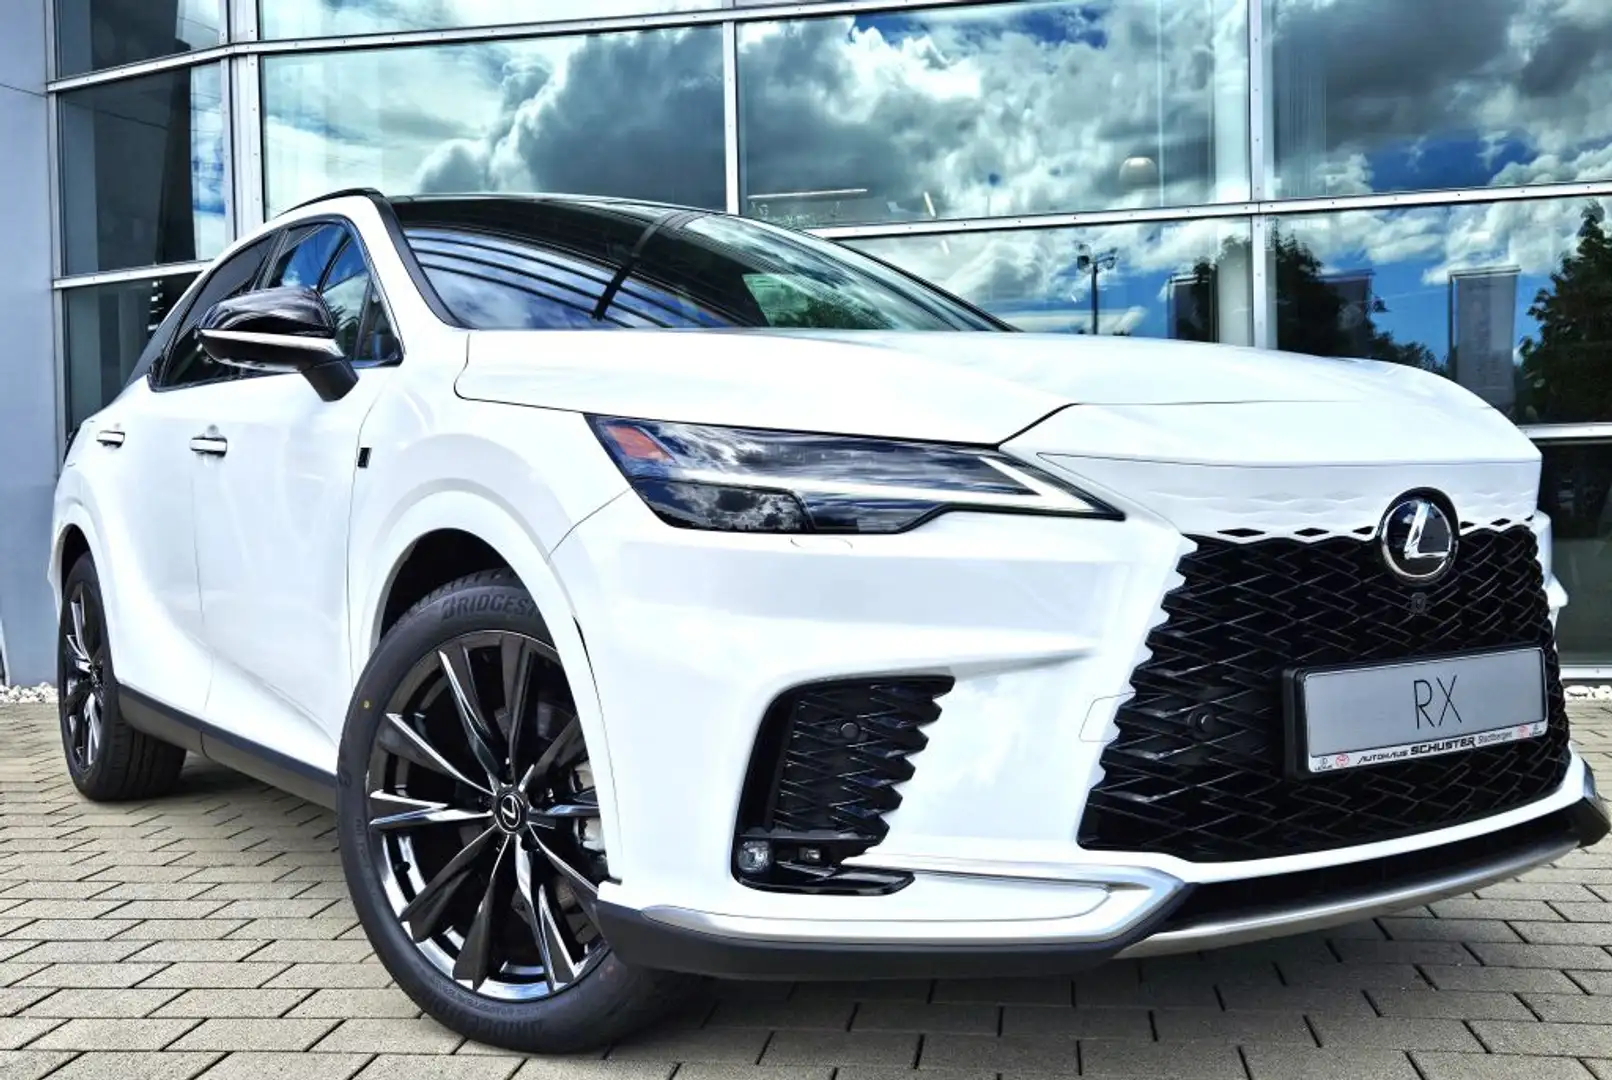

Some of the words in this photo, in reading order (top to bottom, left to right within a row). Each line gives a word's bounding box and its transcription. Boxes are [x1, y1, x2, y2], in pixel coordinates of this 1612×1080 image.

[1413, 675, 1462, 730] RX
[1357, 750, 1409, 765] AUTOHAUS
[1410, 736, 1476, 756] SCHUSTER
